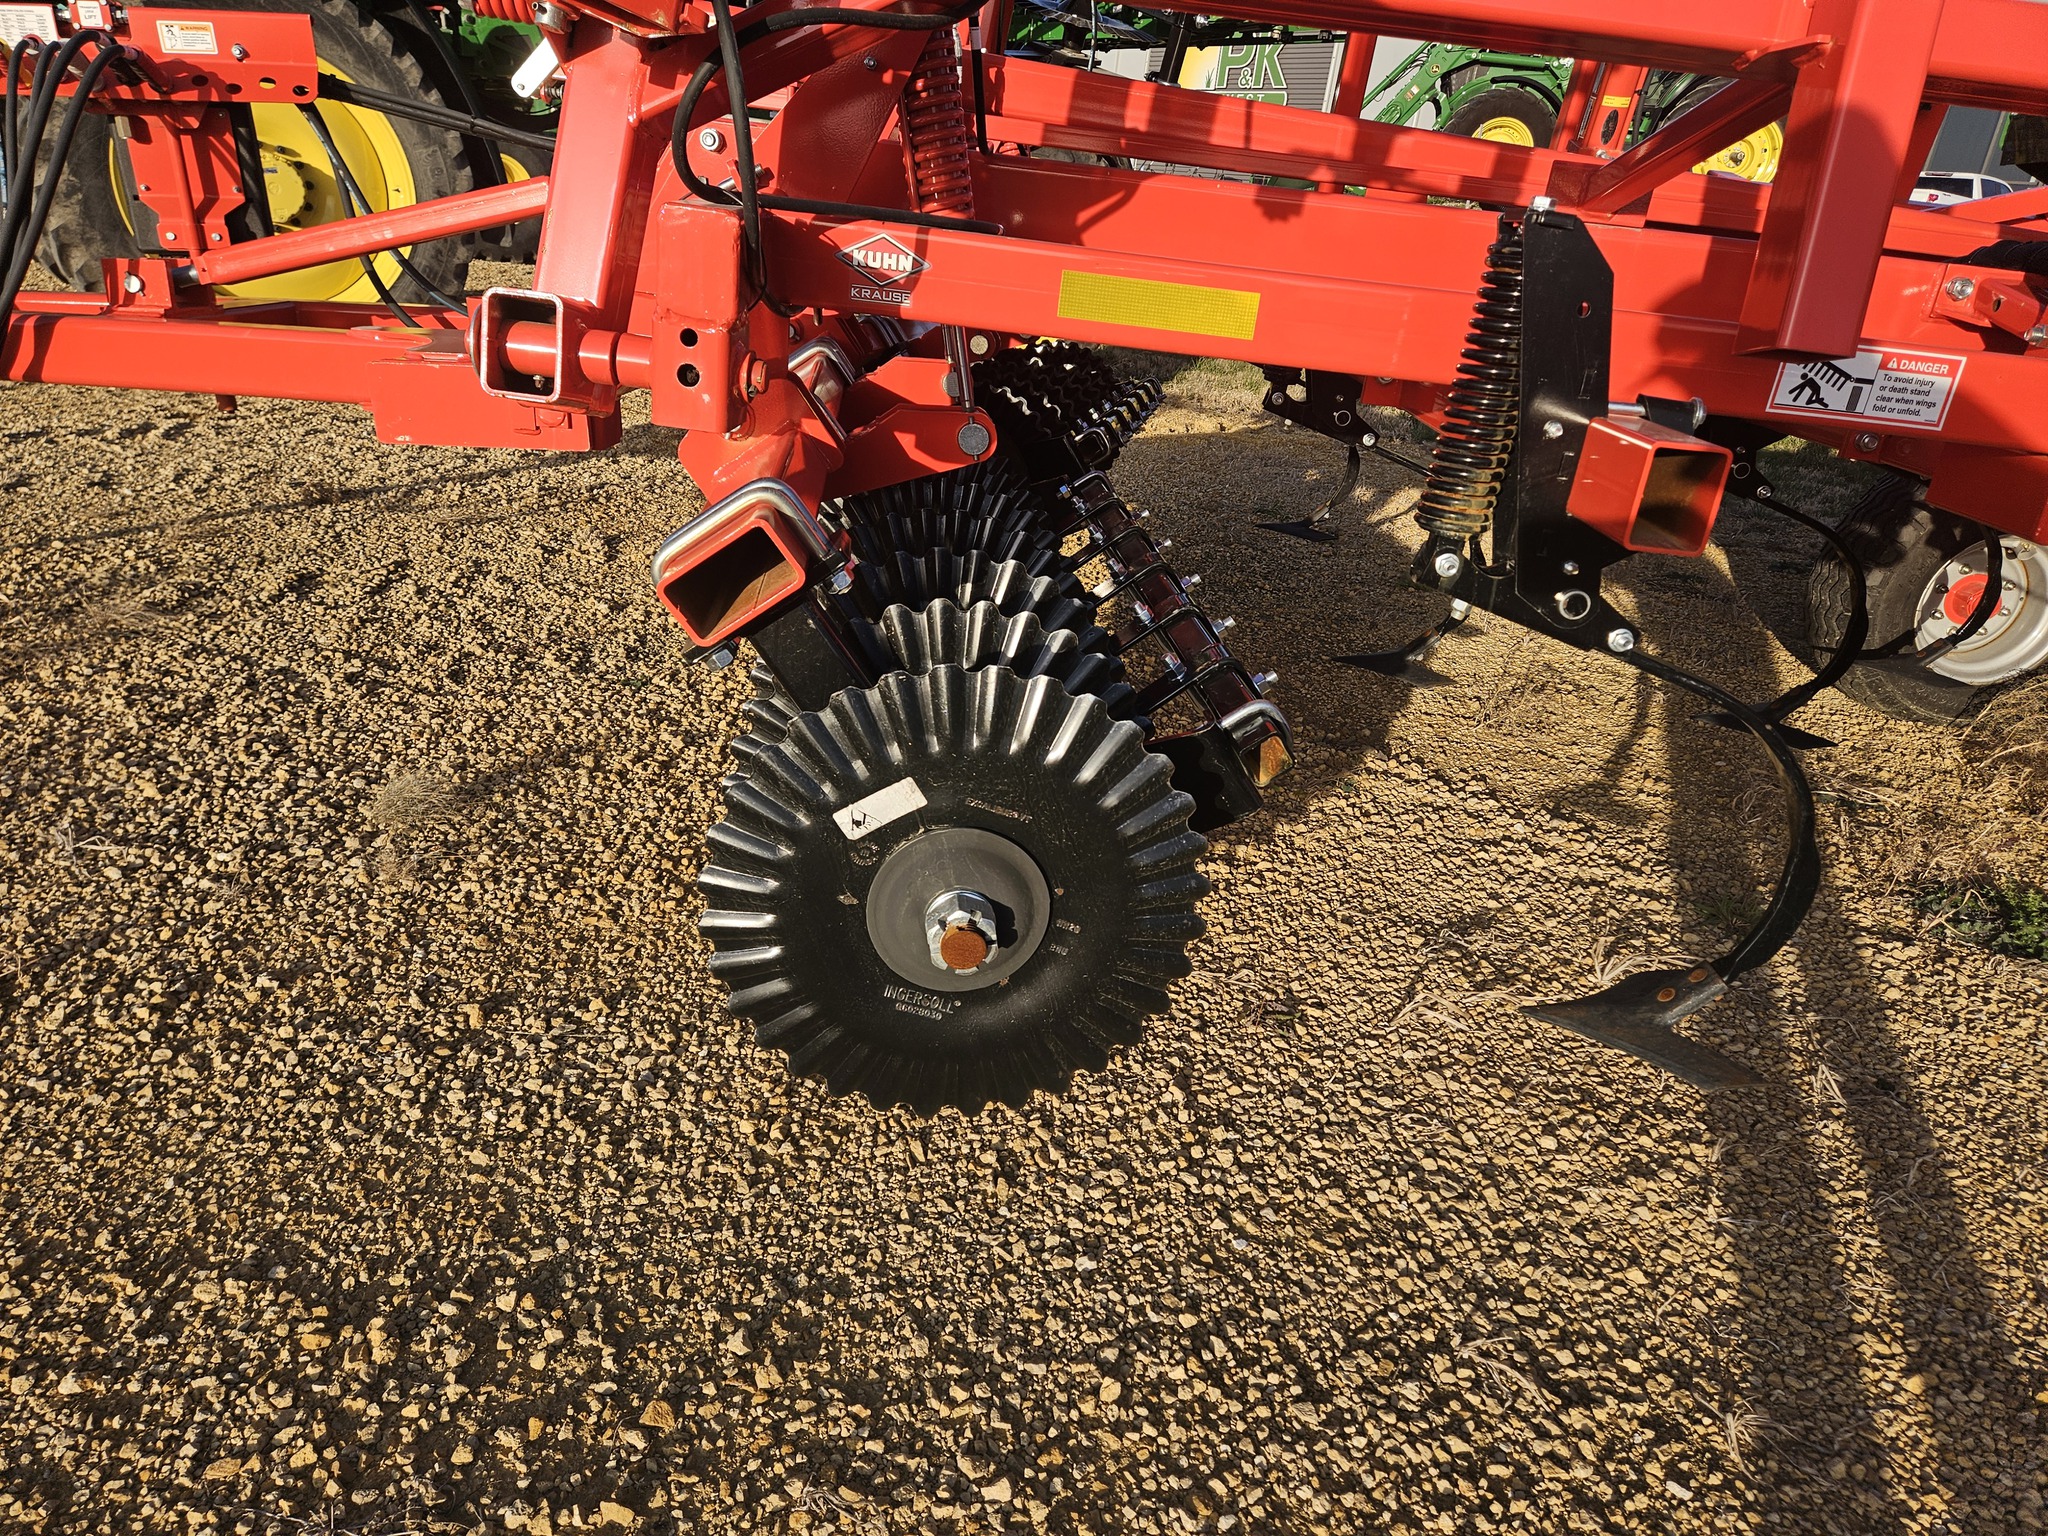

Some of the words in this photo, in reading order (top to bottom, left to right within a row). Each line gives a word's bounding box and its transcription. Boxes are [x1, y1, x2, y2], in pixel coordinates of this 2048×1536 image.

[1216, 44, 1288, 89] P&K
[852, 249, 914, 272] KUHN
[850, 287, 911, 304] KRAUSE
[1900, 360, 1949, 374] DANGER
[1883, 373, 1893, 382] To
[1893, 376, 1914, 384] avoid
[1914, 378, 1936, 388] injury
[1888, 385, 1909, 394] death
[1909, 388, 1931, 397] stand
[1875, 394, 1894, 403] clear
[1894, 396, 1914, 405] when
[1915, 399, 1937, 409] wings
[1872, 403, 1887, 412] fold
[1896, 407, 1921, 417] unfold.
